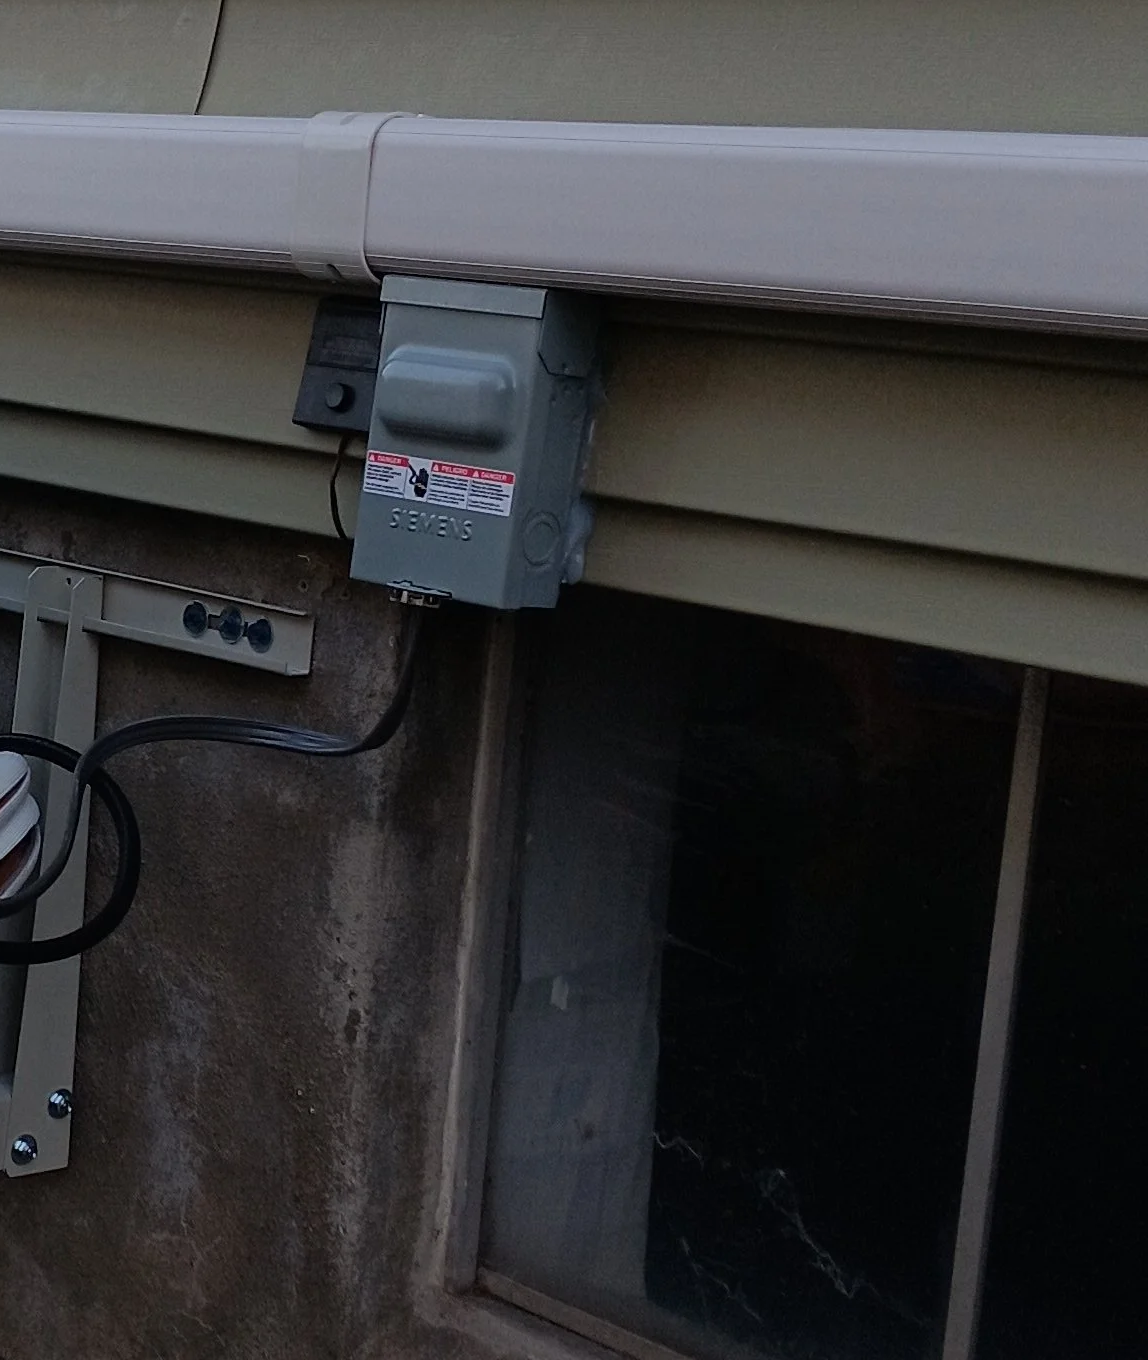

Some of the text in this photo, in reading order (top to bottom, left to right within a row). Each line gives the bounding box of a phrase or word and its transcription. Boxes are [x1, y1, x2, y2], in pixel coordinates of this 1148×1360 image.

[377, 455, 402, 464] DANGER
[441, 465, 468, 476] PELIGRO
[480, 471, 508, 481] DANGER
[389, 507, 473, 541] SIEMENS
